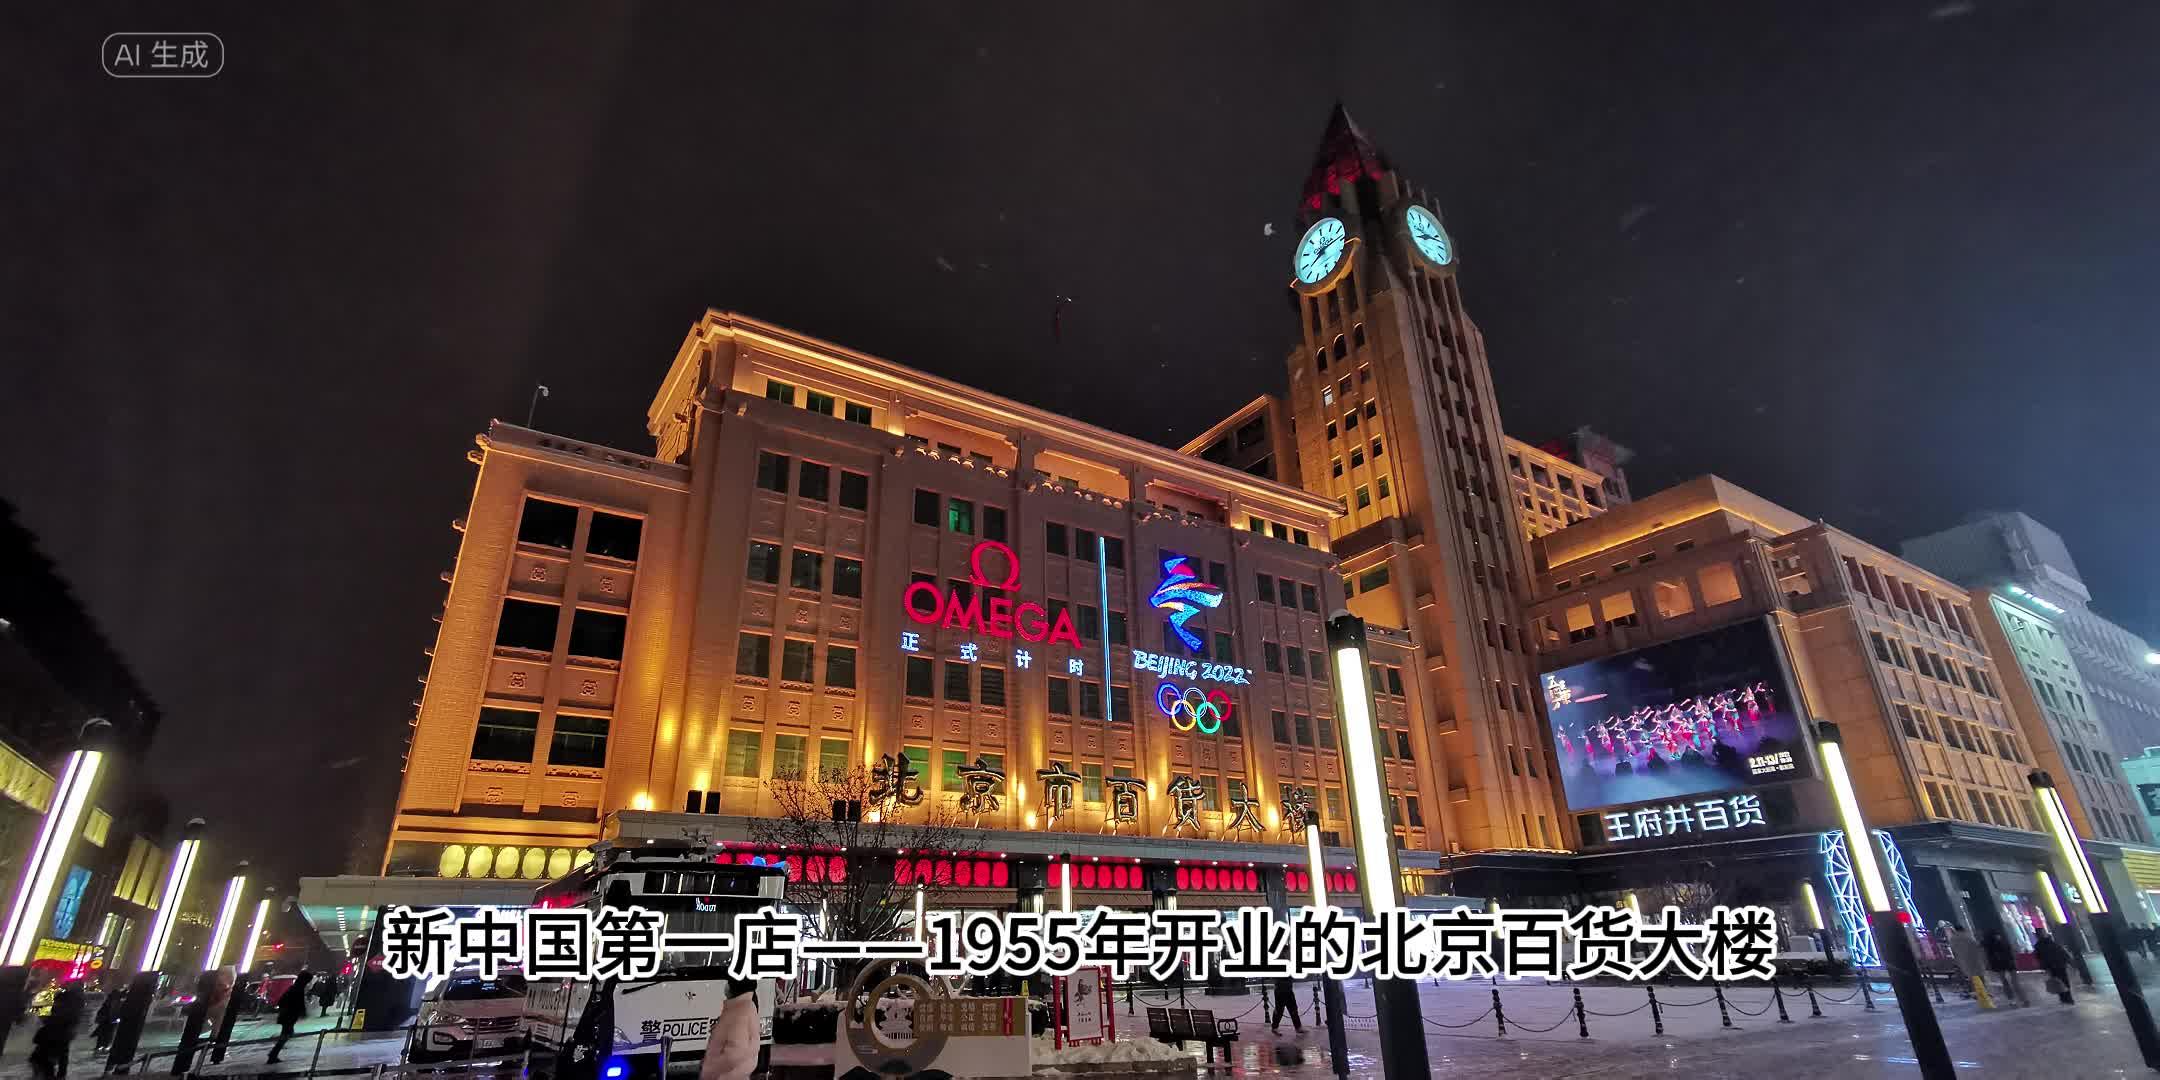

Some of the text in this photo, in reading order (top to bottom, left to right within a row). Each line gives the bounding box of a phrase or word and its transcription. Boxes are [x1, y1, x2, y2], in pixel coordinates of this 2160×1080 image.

[904, 581, 1083, 649] OMEGA
[901, 631, 1084, 676] 正式计时
[1132, 649, 1250, 684] BEIJING 2022
[1604, 794, 1766, 841] 王府井百货
[663, 1021, 708, 1036] POLICE
